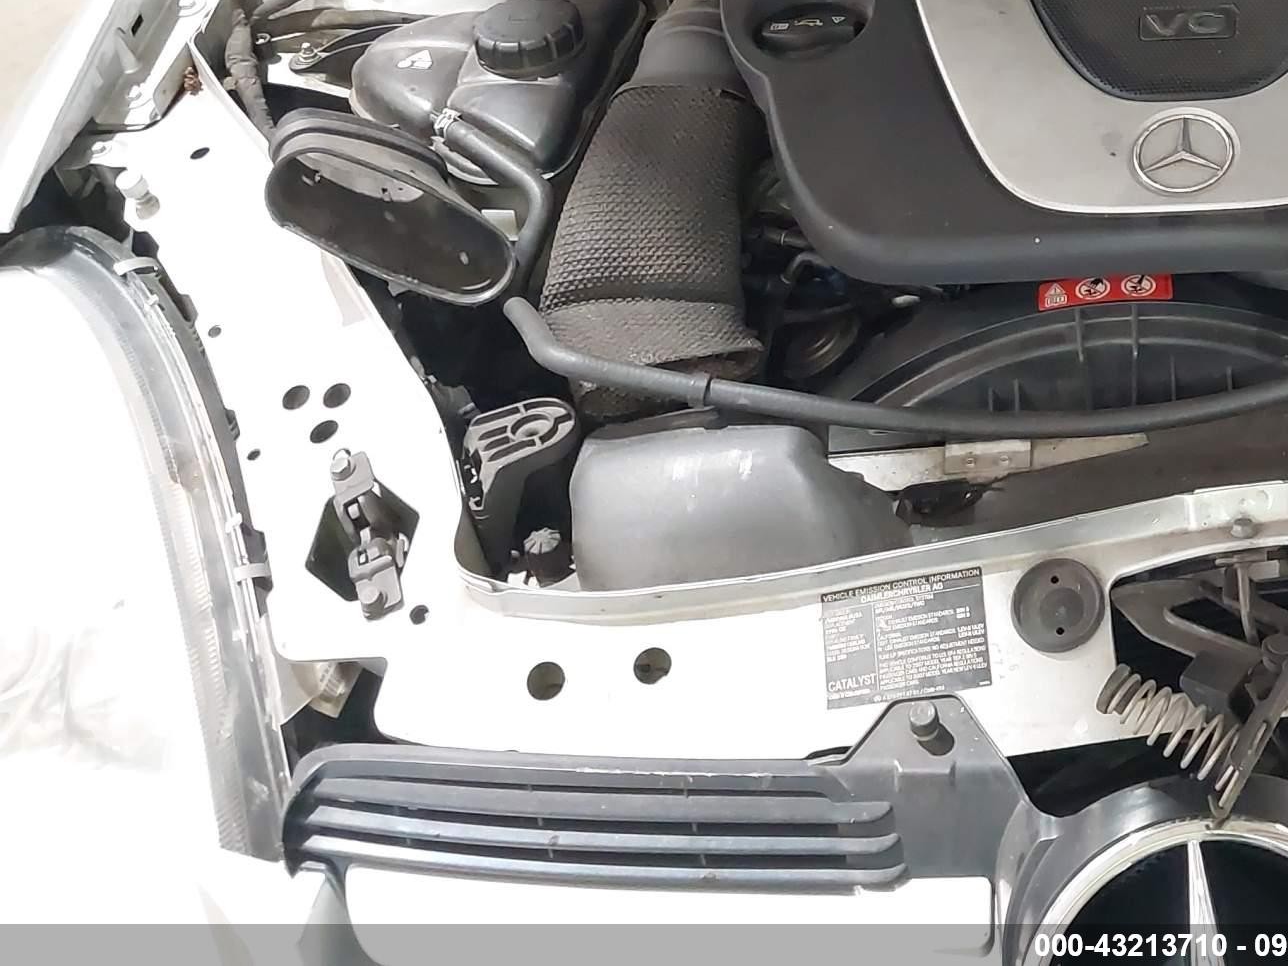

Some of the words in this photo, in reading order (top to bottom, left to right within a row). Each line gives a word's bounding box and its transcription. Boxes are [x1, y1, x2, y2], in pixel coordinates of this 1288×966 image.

[822, 590, 854, 602] VEHICLE
[855, 582, 891, 596] EMISSION
[892, 577, 928, 589] CONTROL
[929, 569, 980, 584] INFORMATION
[861, 584, 931, 603] DAIMLERCHRYSLER
[932, 582, 944, 591] AG
[828, 673, 876, 693] CATALYST
